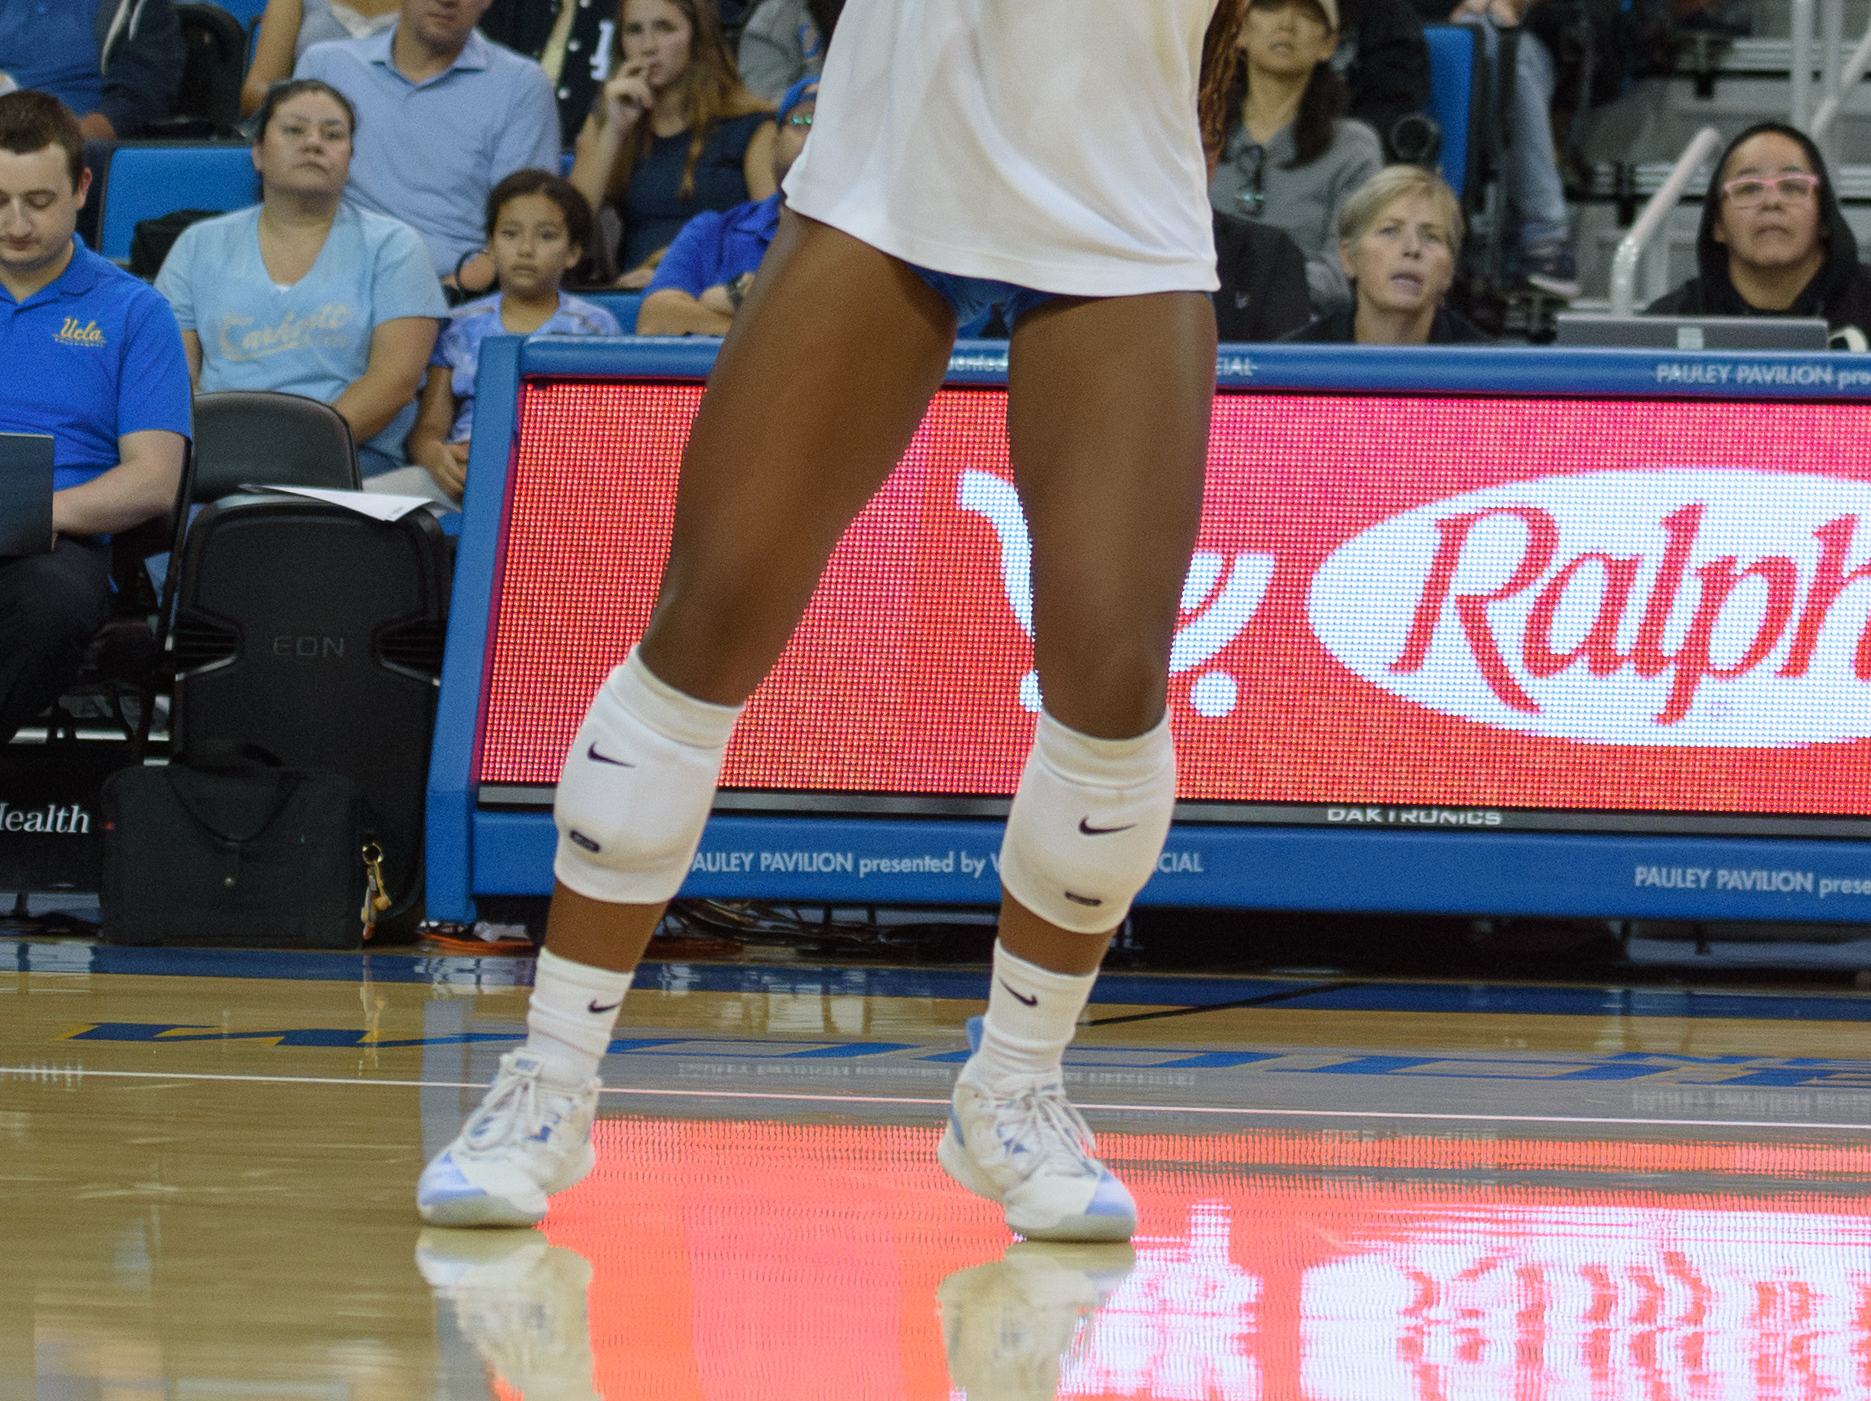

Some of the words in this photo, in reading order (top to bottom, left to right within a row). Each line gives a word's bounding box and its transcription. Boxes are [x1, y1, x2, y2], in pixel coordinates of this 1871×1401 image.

[1656, 363, 1732, 384] PAULEY
[1737, 364, 1832, 385] PAVILION
[273, 635, 344, 657] EON
[1327, 808, 1502, 826] DAKTRONICS
[691, 851, 754, 873] AULEY
[760, 851, 853, 873] PAVILION
[859, 850, 954, 879] presented
[960, 851, 986, 879] by
[1635, 865, 1711, 889] PAULEY
[1716, 868, 1815, 893] PAVILION
